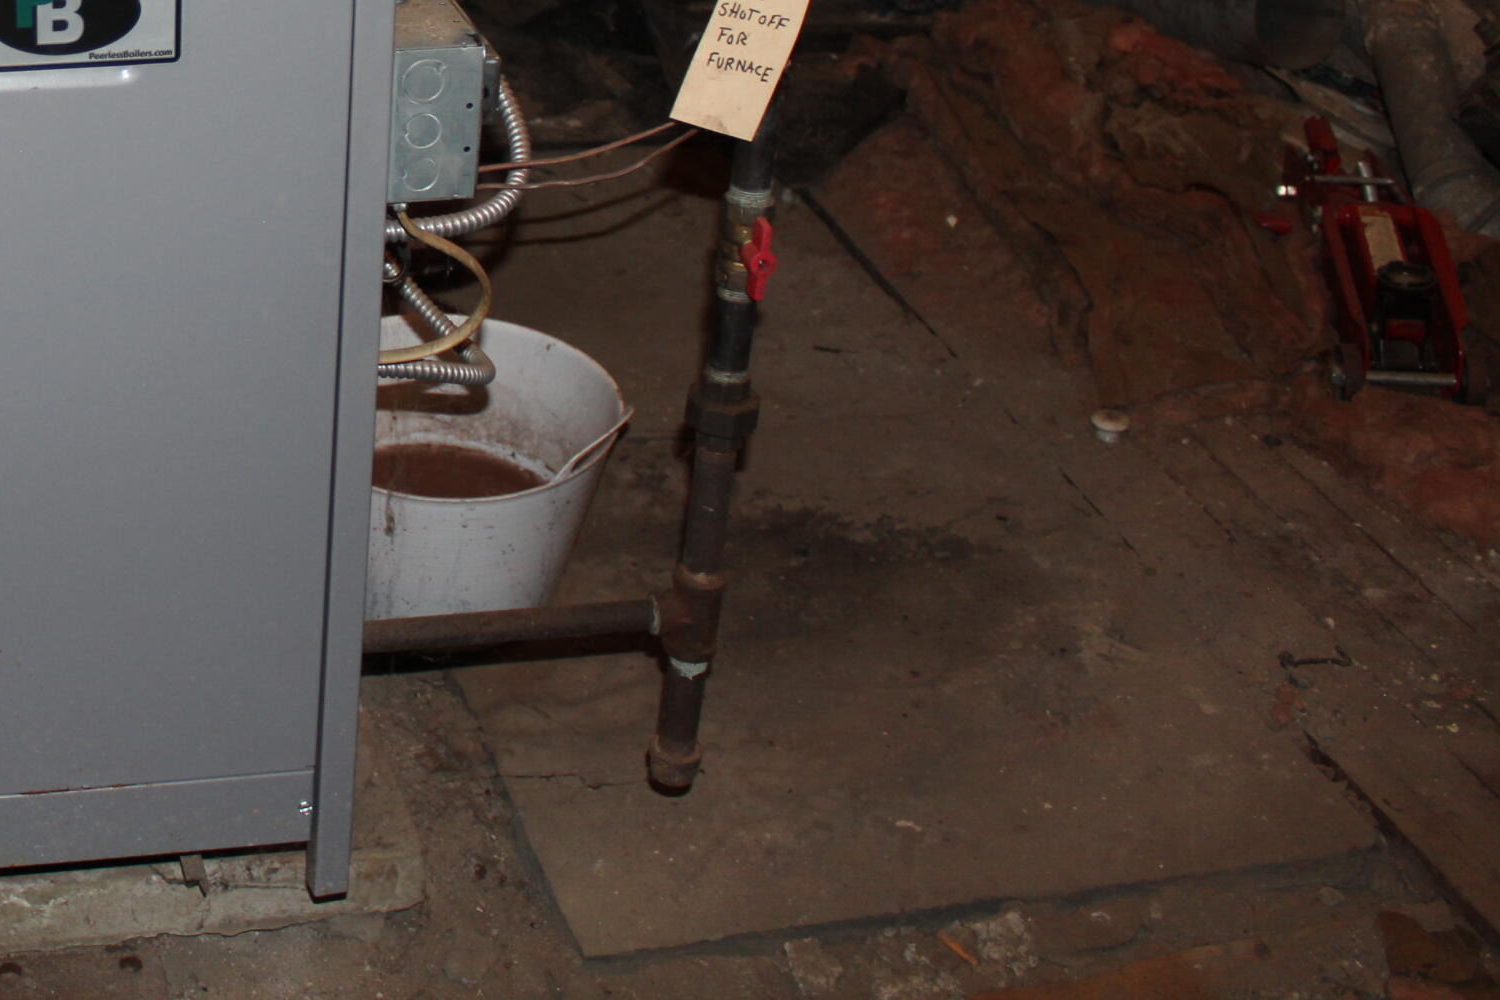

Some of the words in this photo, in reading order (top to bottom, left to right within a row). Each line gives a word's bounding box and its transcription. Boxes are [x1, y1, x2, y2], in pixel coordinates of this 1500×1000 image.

[717, 26, 748, 46] FOR
[88, 49, 173, 60] PeerlessBoilers.com
[706, 52, 774, 82] FURNACE
